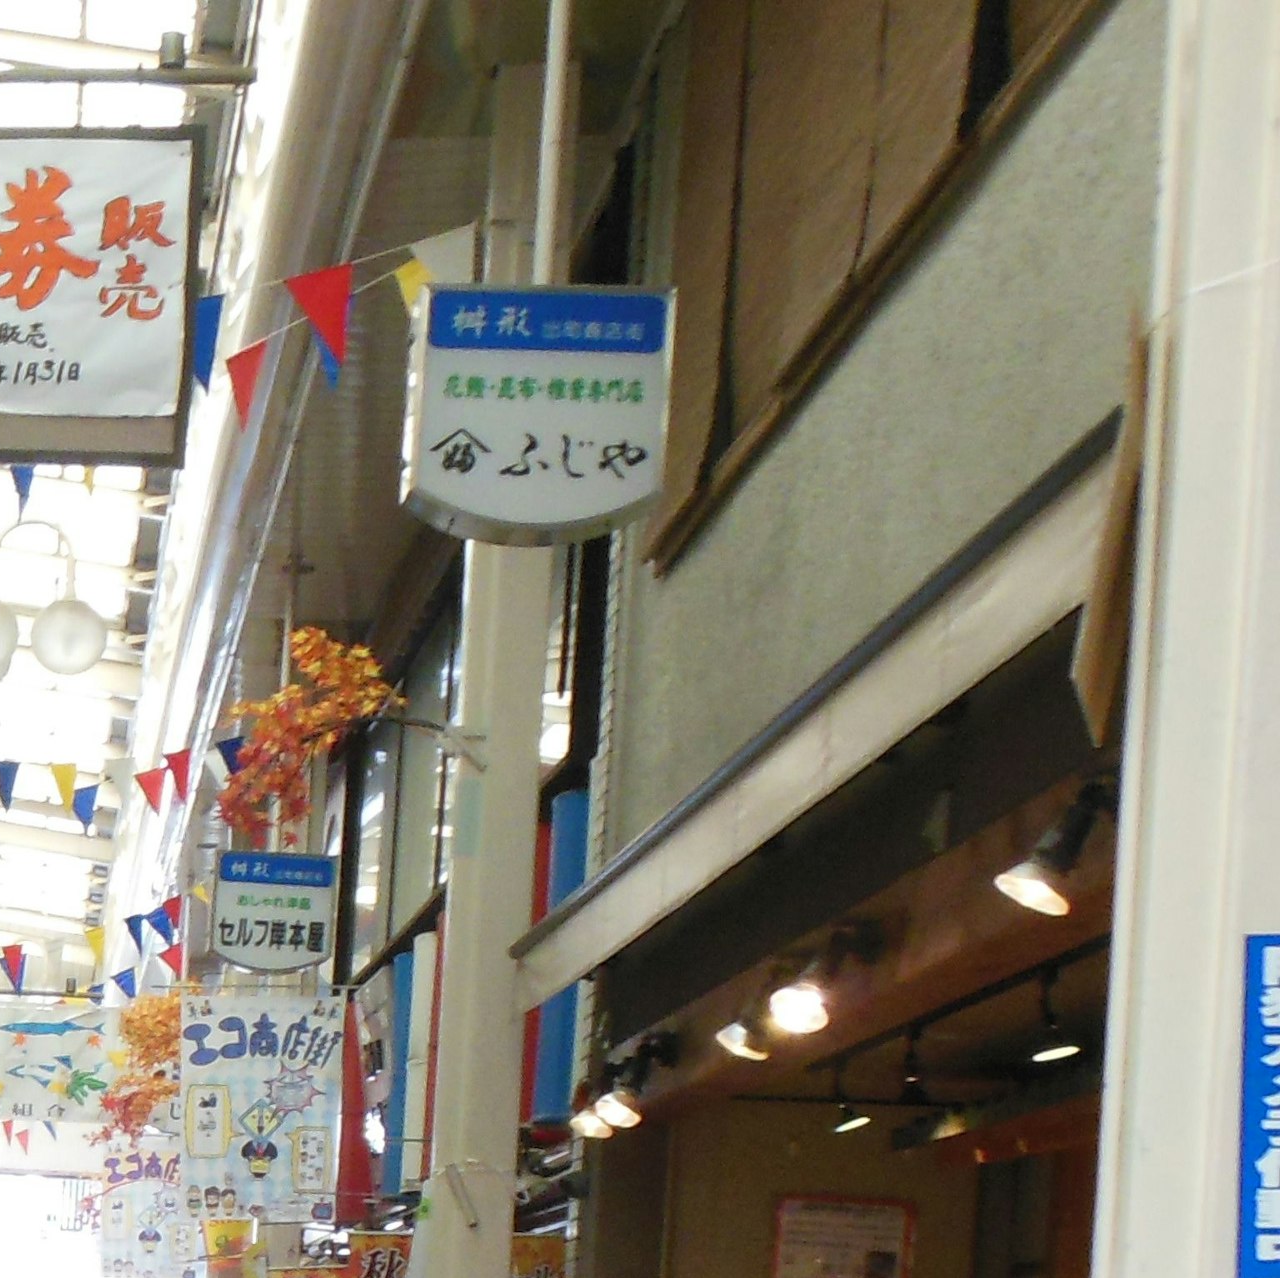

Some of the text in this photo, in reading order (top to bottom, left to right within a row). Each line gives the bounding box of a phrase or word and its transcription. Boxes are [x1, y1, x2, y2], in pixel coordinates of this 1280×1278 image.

[97, 195, 177, 322] 販売
[498, 432, 648, 480] ふじや
[218, 917, 326, 954] セルフ岸本屋
[182, 1012, 342, 1068] エコ商店街
